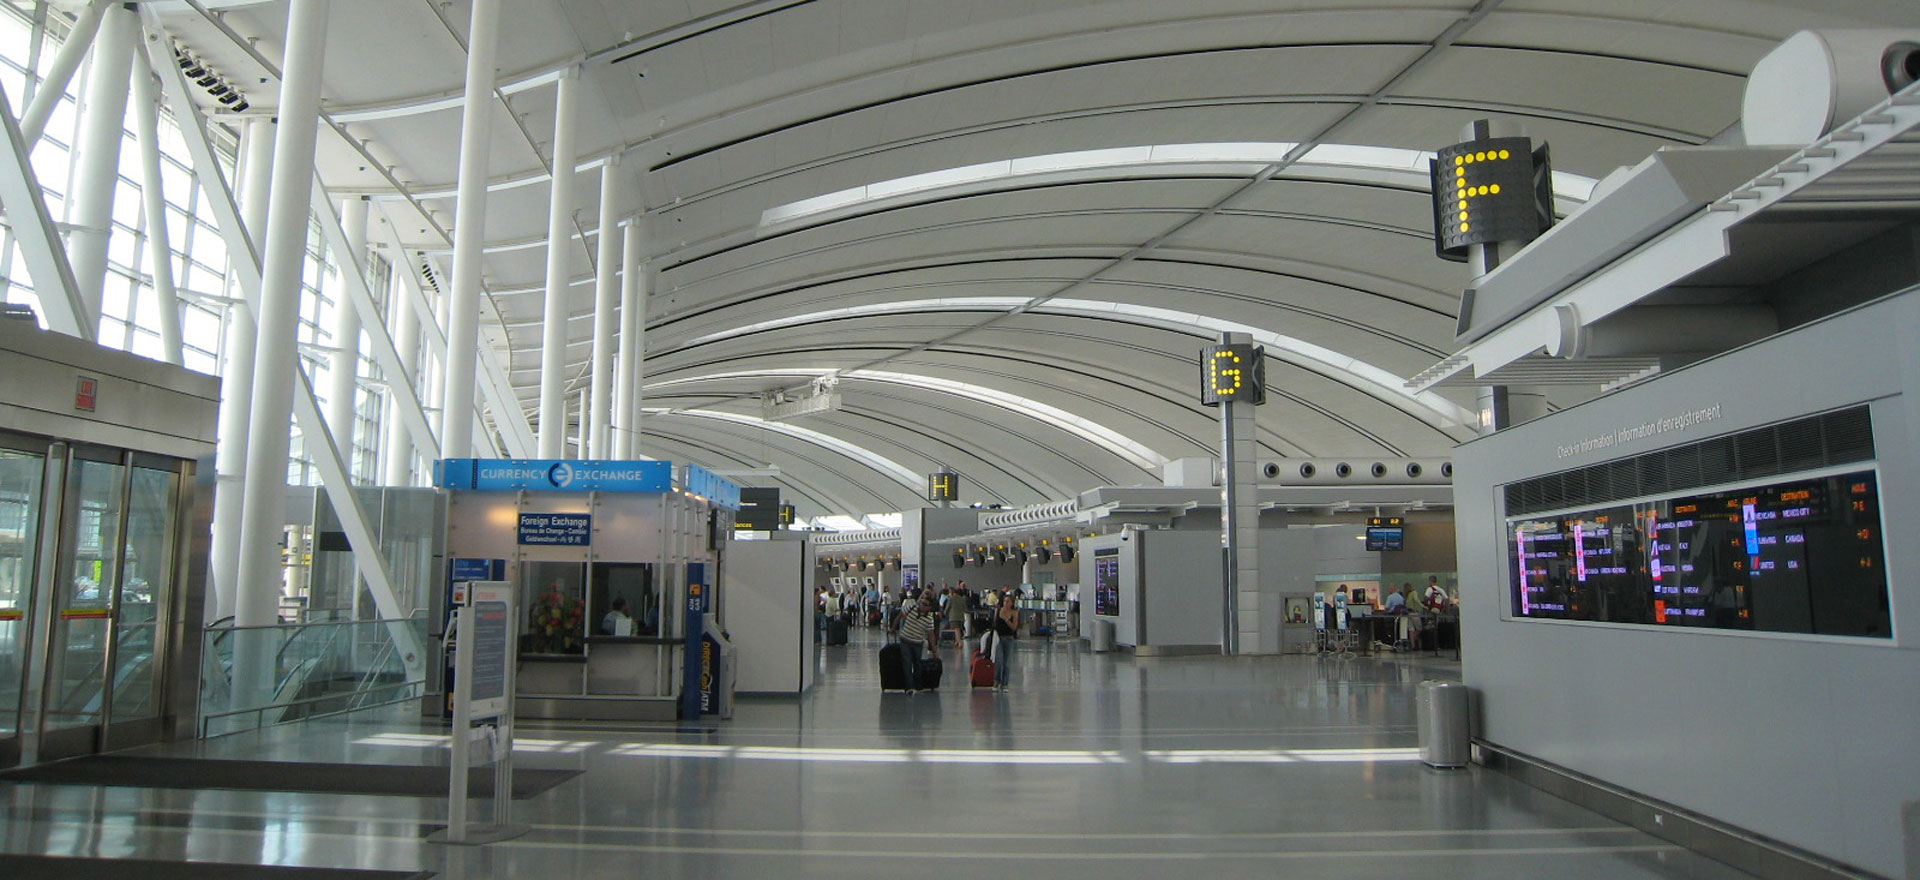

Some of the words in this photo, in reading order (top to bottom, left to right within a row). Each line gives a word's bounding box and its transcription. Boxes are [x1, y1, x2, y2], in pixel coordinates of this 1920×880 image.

[1454, 149, 1510, 233] F
[1210, 350, 1241, 395] G
[1556, 443, 1581, 460] Check-in
[1580, 434, 1614, 453] Information
[1617, 421, 1656, 444] Information
[1656, 402, 1722, 434] d'enregistrement
[480, 468, 546, 480] CURRENCY
[575, 469, 643, 481] EXCHANGE
[932, 475, 949, 498] H
[521, 516, 549, 528] Foreign
[551, 516, 588, 529] Exchange
[546, 528, 565, 536] Change
